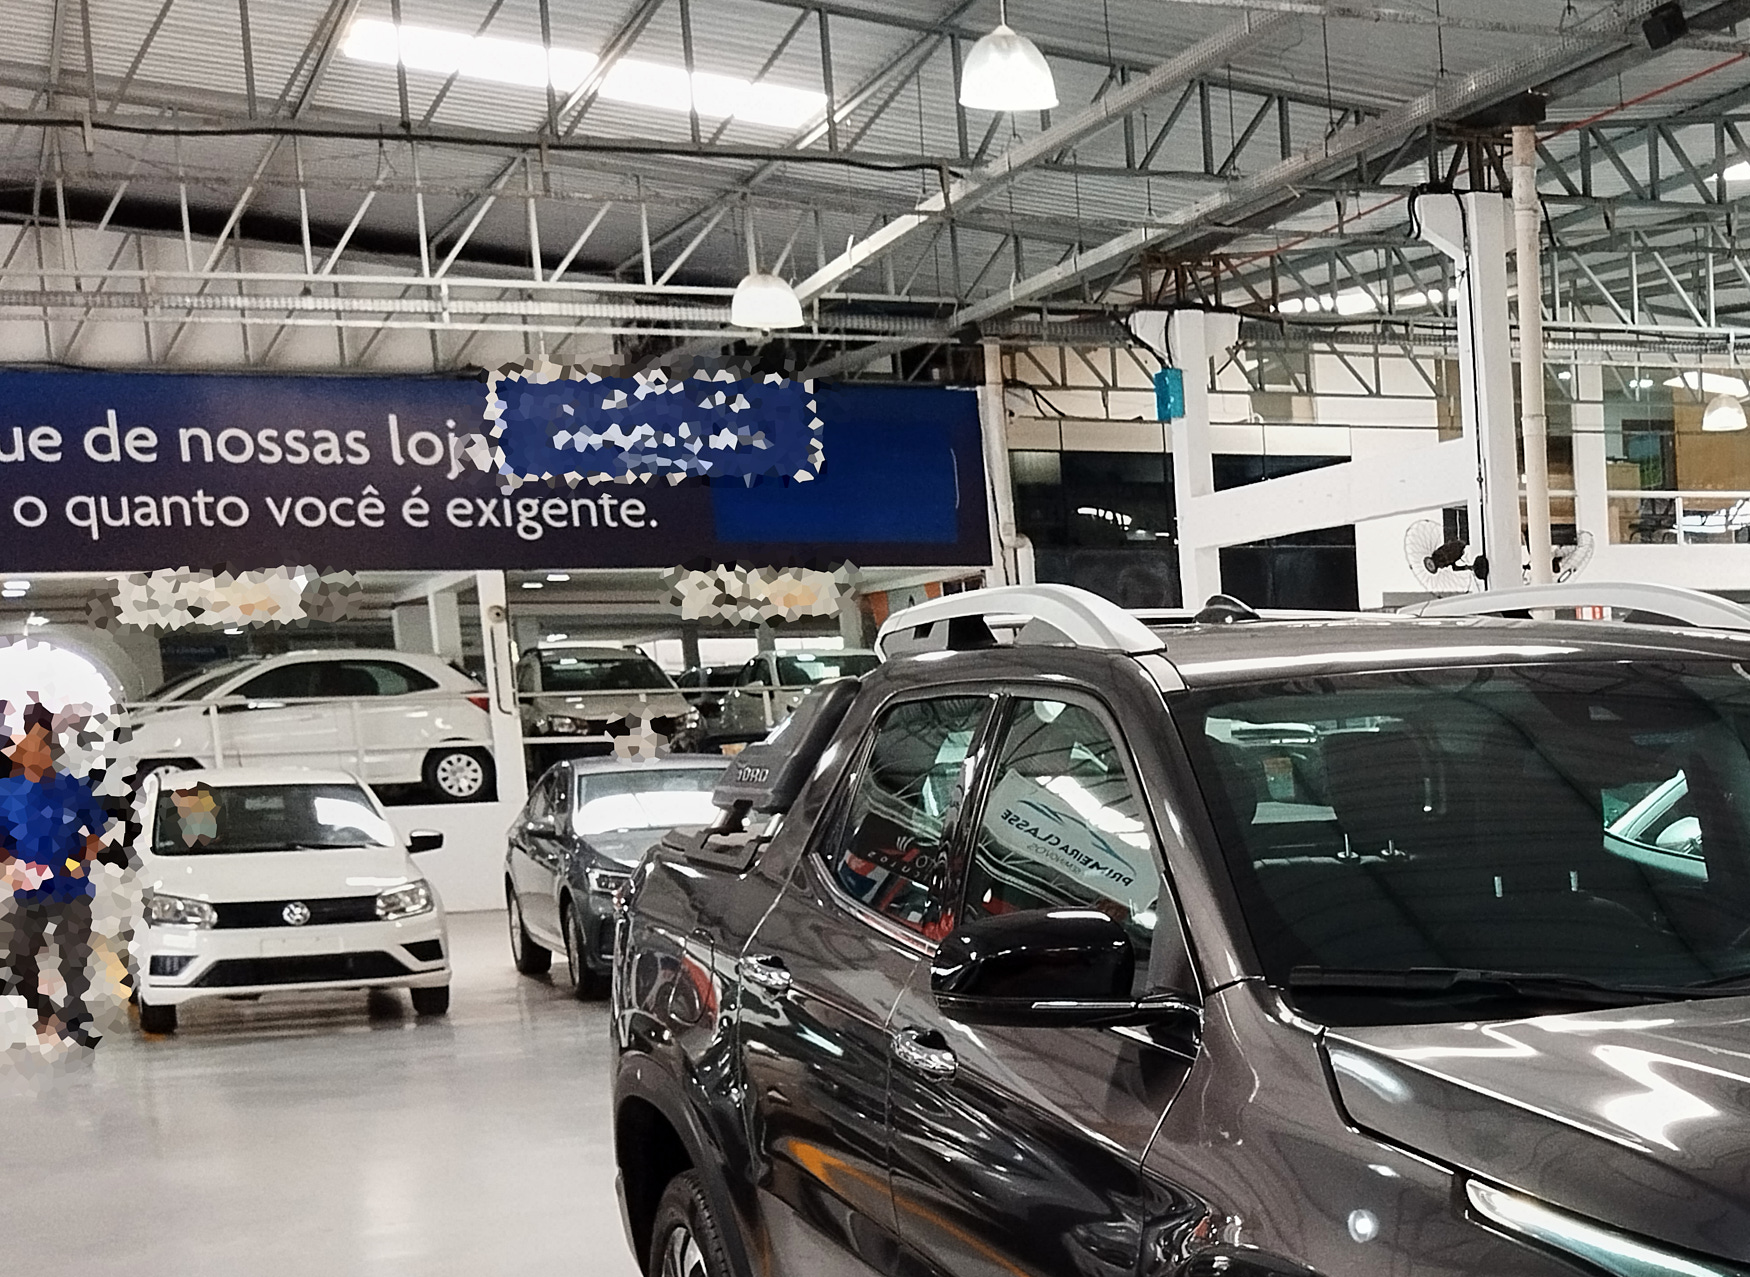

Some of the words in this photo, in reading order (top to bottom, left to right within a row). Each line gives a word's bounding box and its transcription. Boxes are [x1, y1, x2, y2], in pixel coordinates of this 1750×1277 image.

[83, 409, 159, 463] de
[179, 427, 371, 465] nossas
[388, 413, 480, 480] loj
[13, 495, 48, 528] o
[65, 489, 250, 541] quanto
[265, 484, 386, 528] você
[402, 485, 430, 528] é
[446, 493, 658, 541] exigente.
